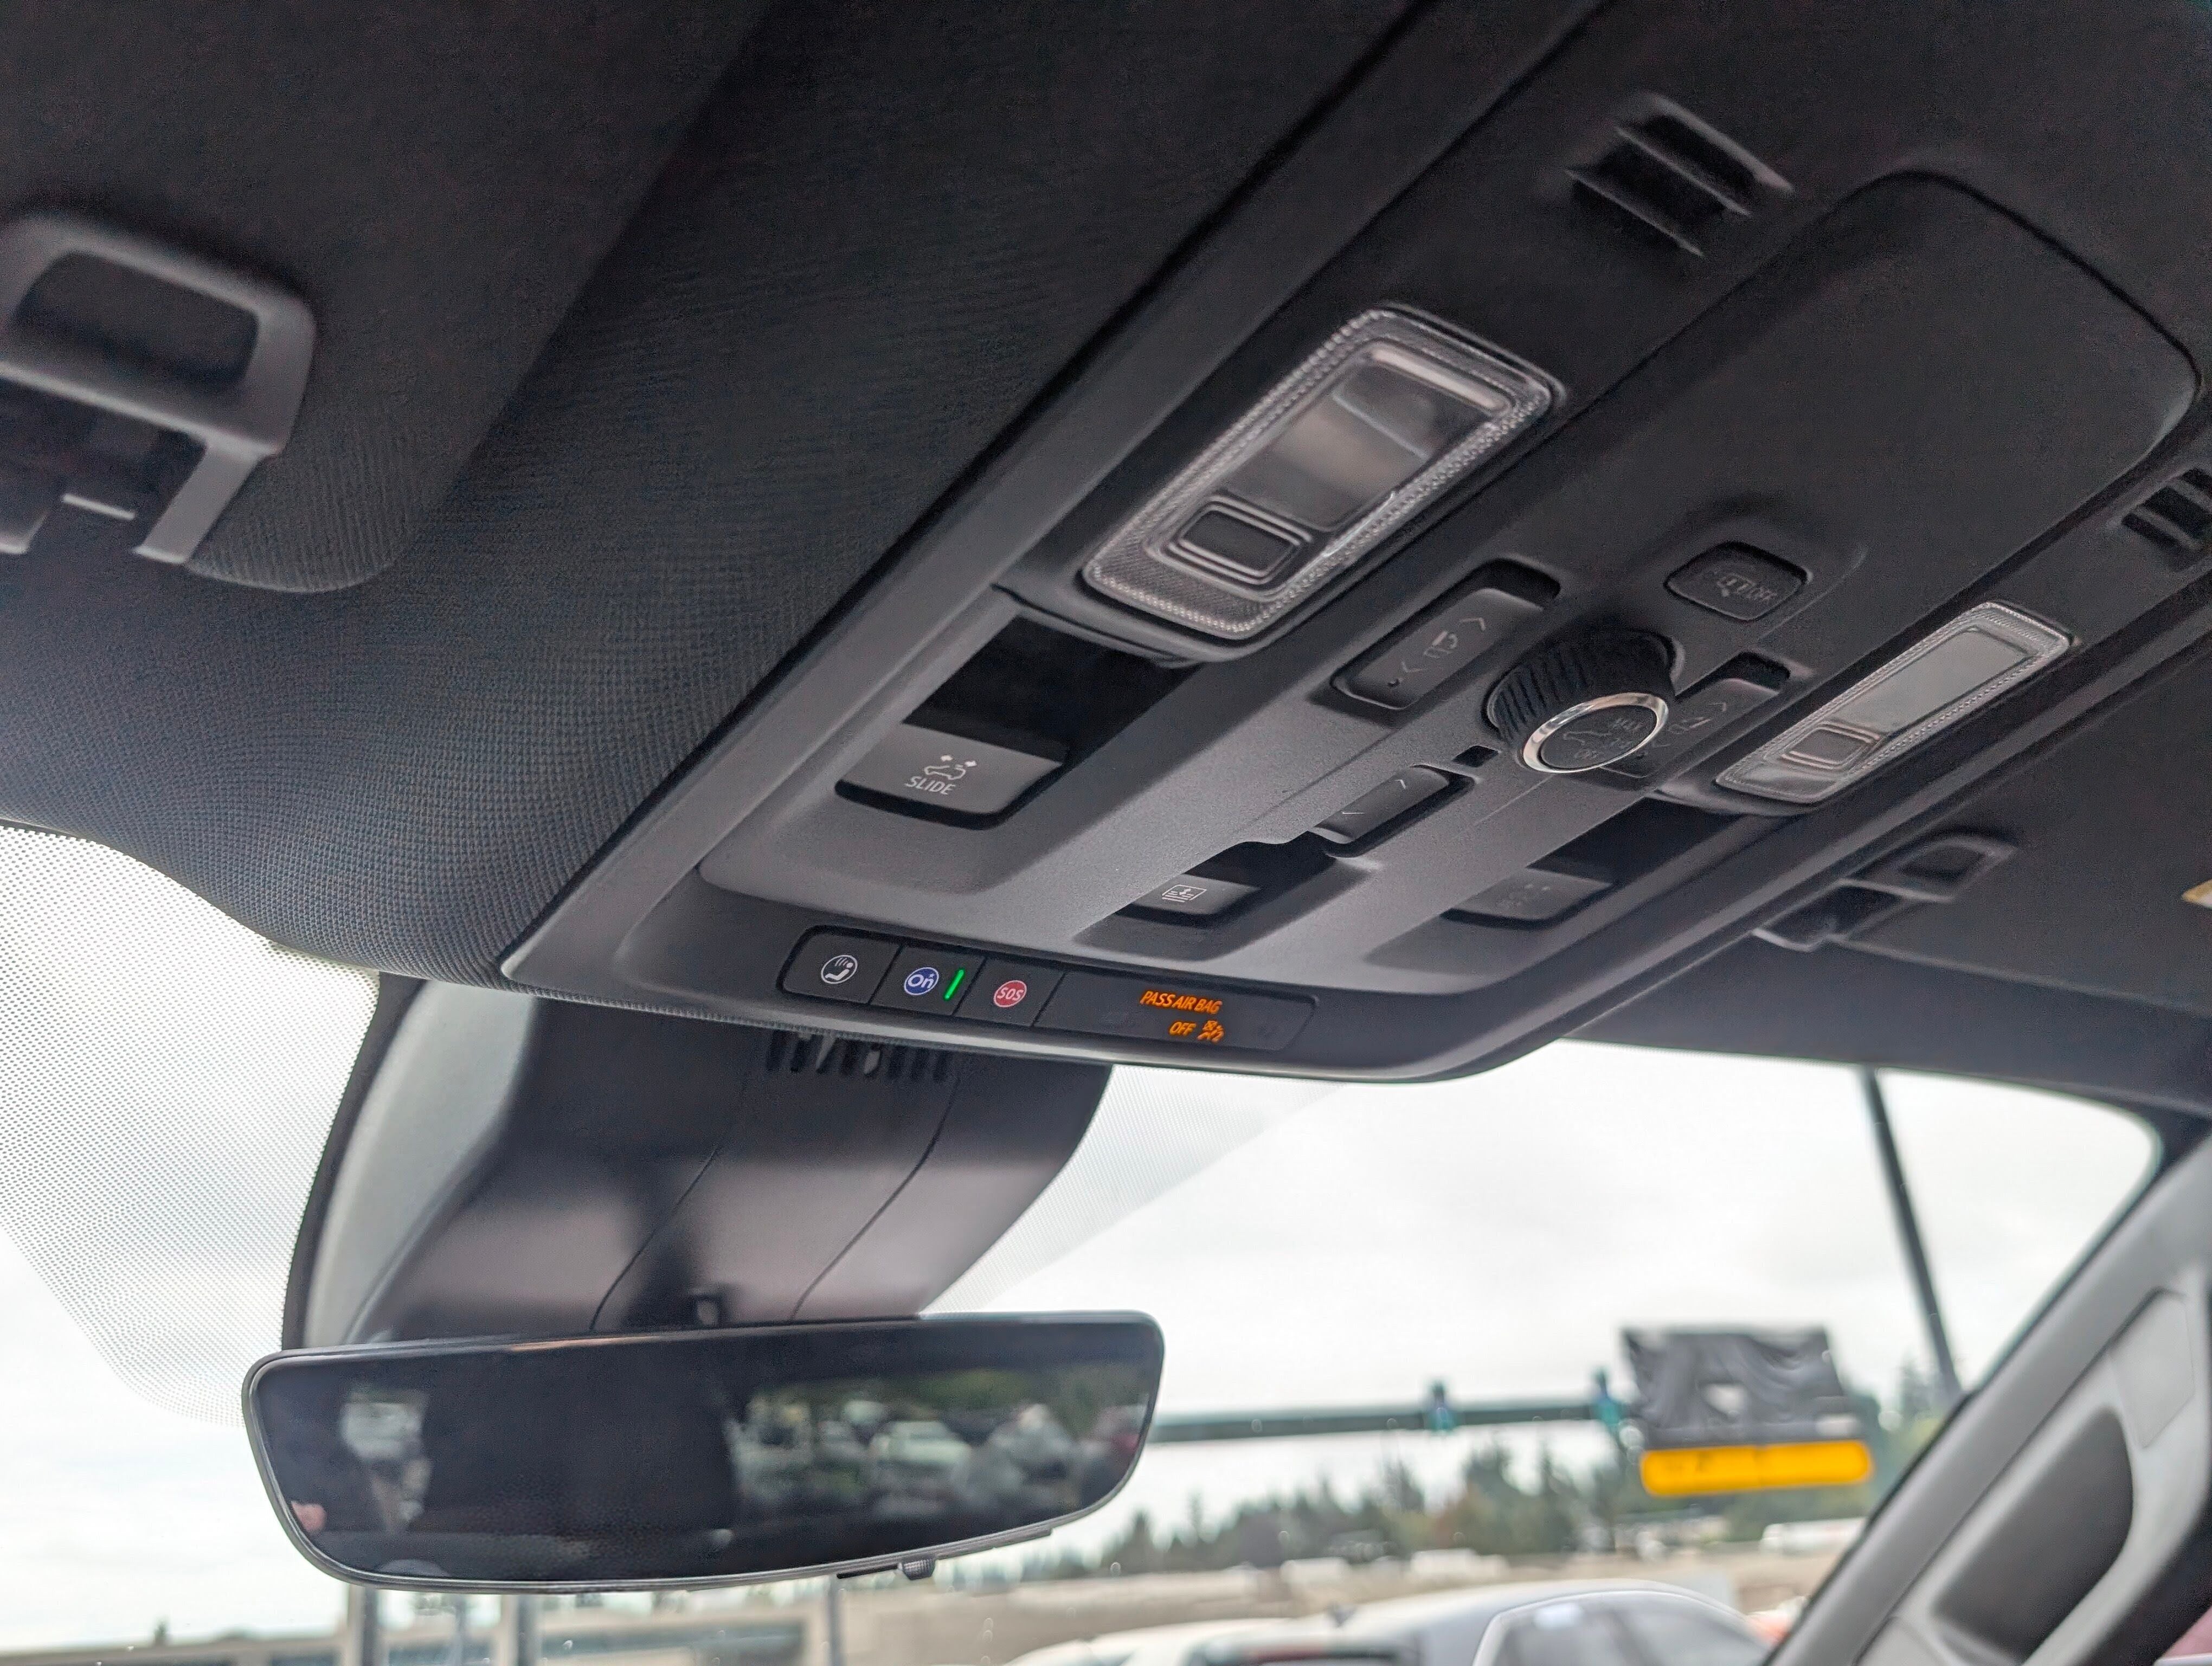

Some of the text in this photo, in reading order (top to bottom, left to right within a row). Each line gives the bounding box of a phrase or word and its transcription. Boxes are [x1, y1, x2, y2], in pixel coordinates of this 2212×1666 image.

[904, 776, 956, 795] SLIDE
[997, 987, 1024, 1001] SOS
[1140, 991, 1223, 1014] PASS AIR BAG
[1169, 1021, 1197, 1035] OFF
